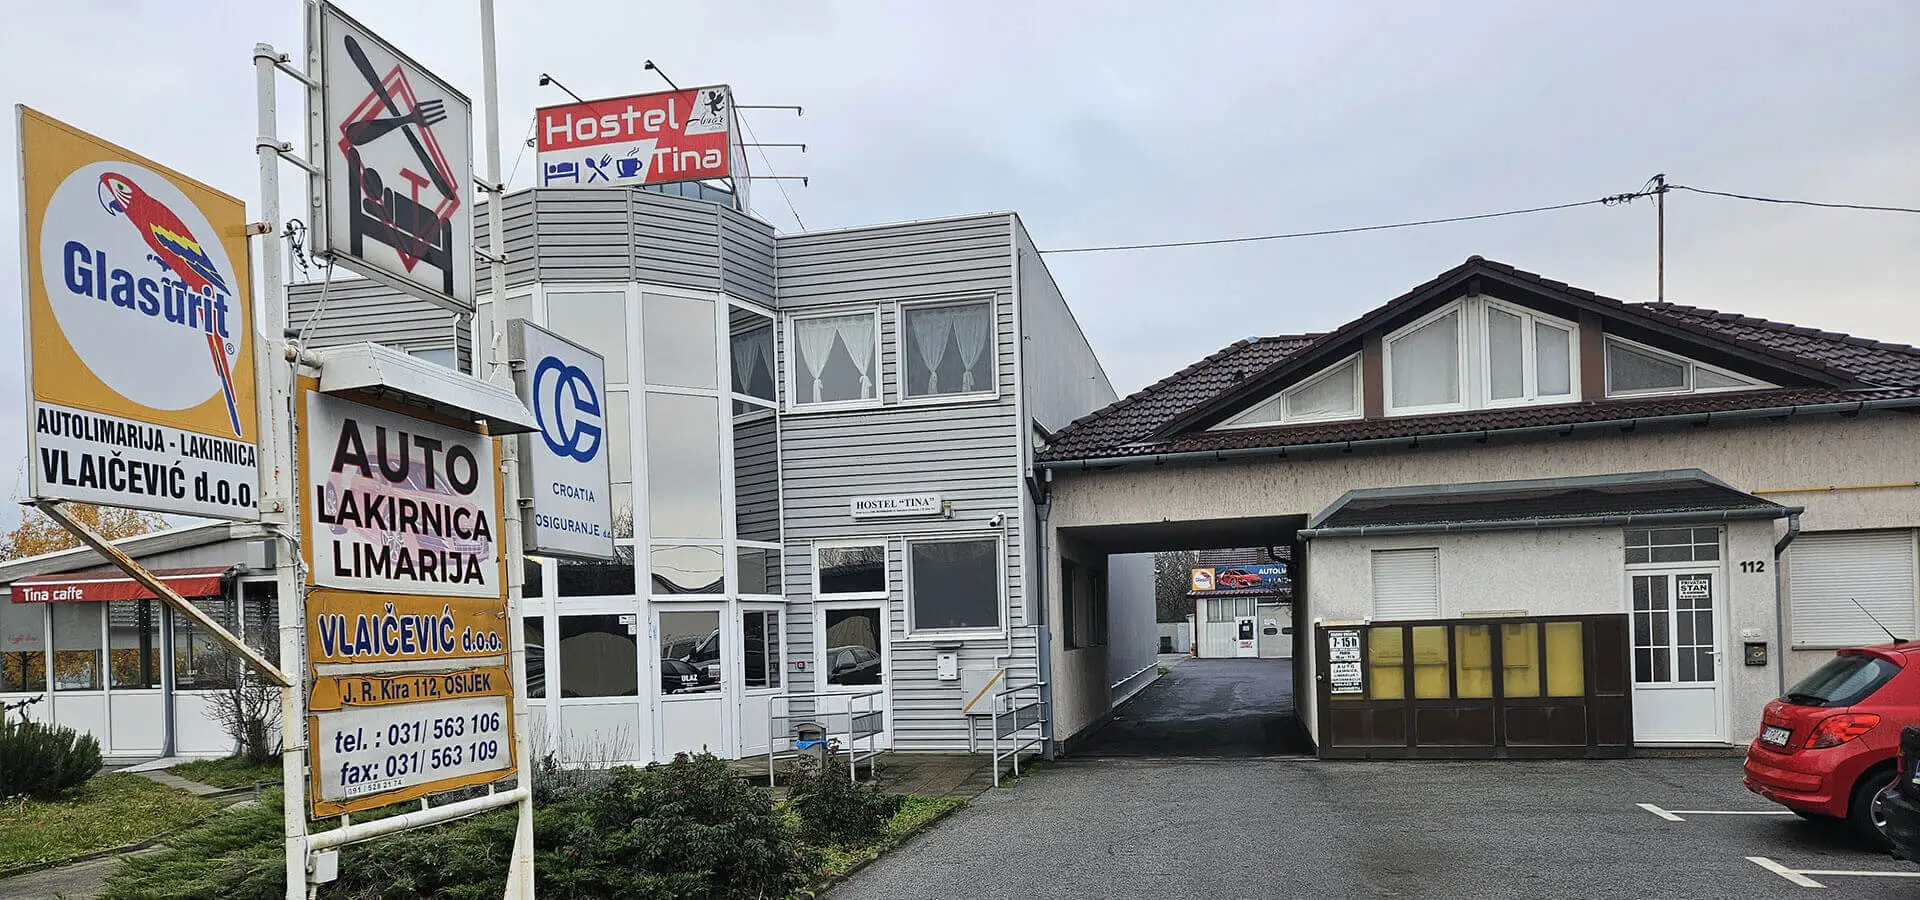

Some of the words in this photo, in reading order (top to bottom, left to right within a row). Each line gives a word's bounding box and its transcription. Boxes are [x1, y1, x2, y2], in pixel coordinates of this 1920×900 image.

[546, 98, 680, 145] Hostel
[652, 146, 722, 174] Tina
[63, 240, 230, 339] Glasurit
[36, 407, 165, 453] AUTOLIMARIJA
[181, 433, 257, 468] LAKIRNICA
[331, 418, 479, 496] AUTO
[40, 448, 185, 499] VLAIČEVIĆ
[194, 471, 258, 508] d.o.o.
[552, 482, 595, 503] CROATIA
[316, 484, 493, 543] LAKIRNICA
[535, 513, 600, 537] OSIGURANJE
[856, 500, 897, 510] HOSTEL
[332, 540, 485, 585] LIMARIJA
[1740, 560, 1765, 573] 112
[23, 587, 49, 602] Tina
[53, 586, 83, 601] caffe
[318, 602, 455, 657] VLAIČEVIĆ
[462, 626, 502, 652] d.o.o.
[343, 682, 357, 703] J.
[361, 681, 377, 702] R.
[381, 678, 410, 700] Kira
[413, 677, 441, 699] 112,
[444, 672, 492, 695] OSIJEK
[388, 719, 427, 746] 031/
[433, 715, 465, 740] 563
[471, 711, 500, 735] 106
[340, 761, 379, 787] fax:
[386, 749, 425, 778] 031/
[431, 744, 462, 770] 563
[469, 740, 498, 763] 109
